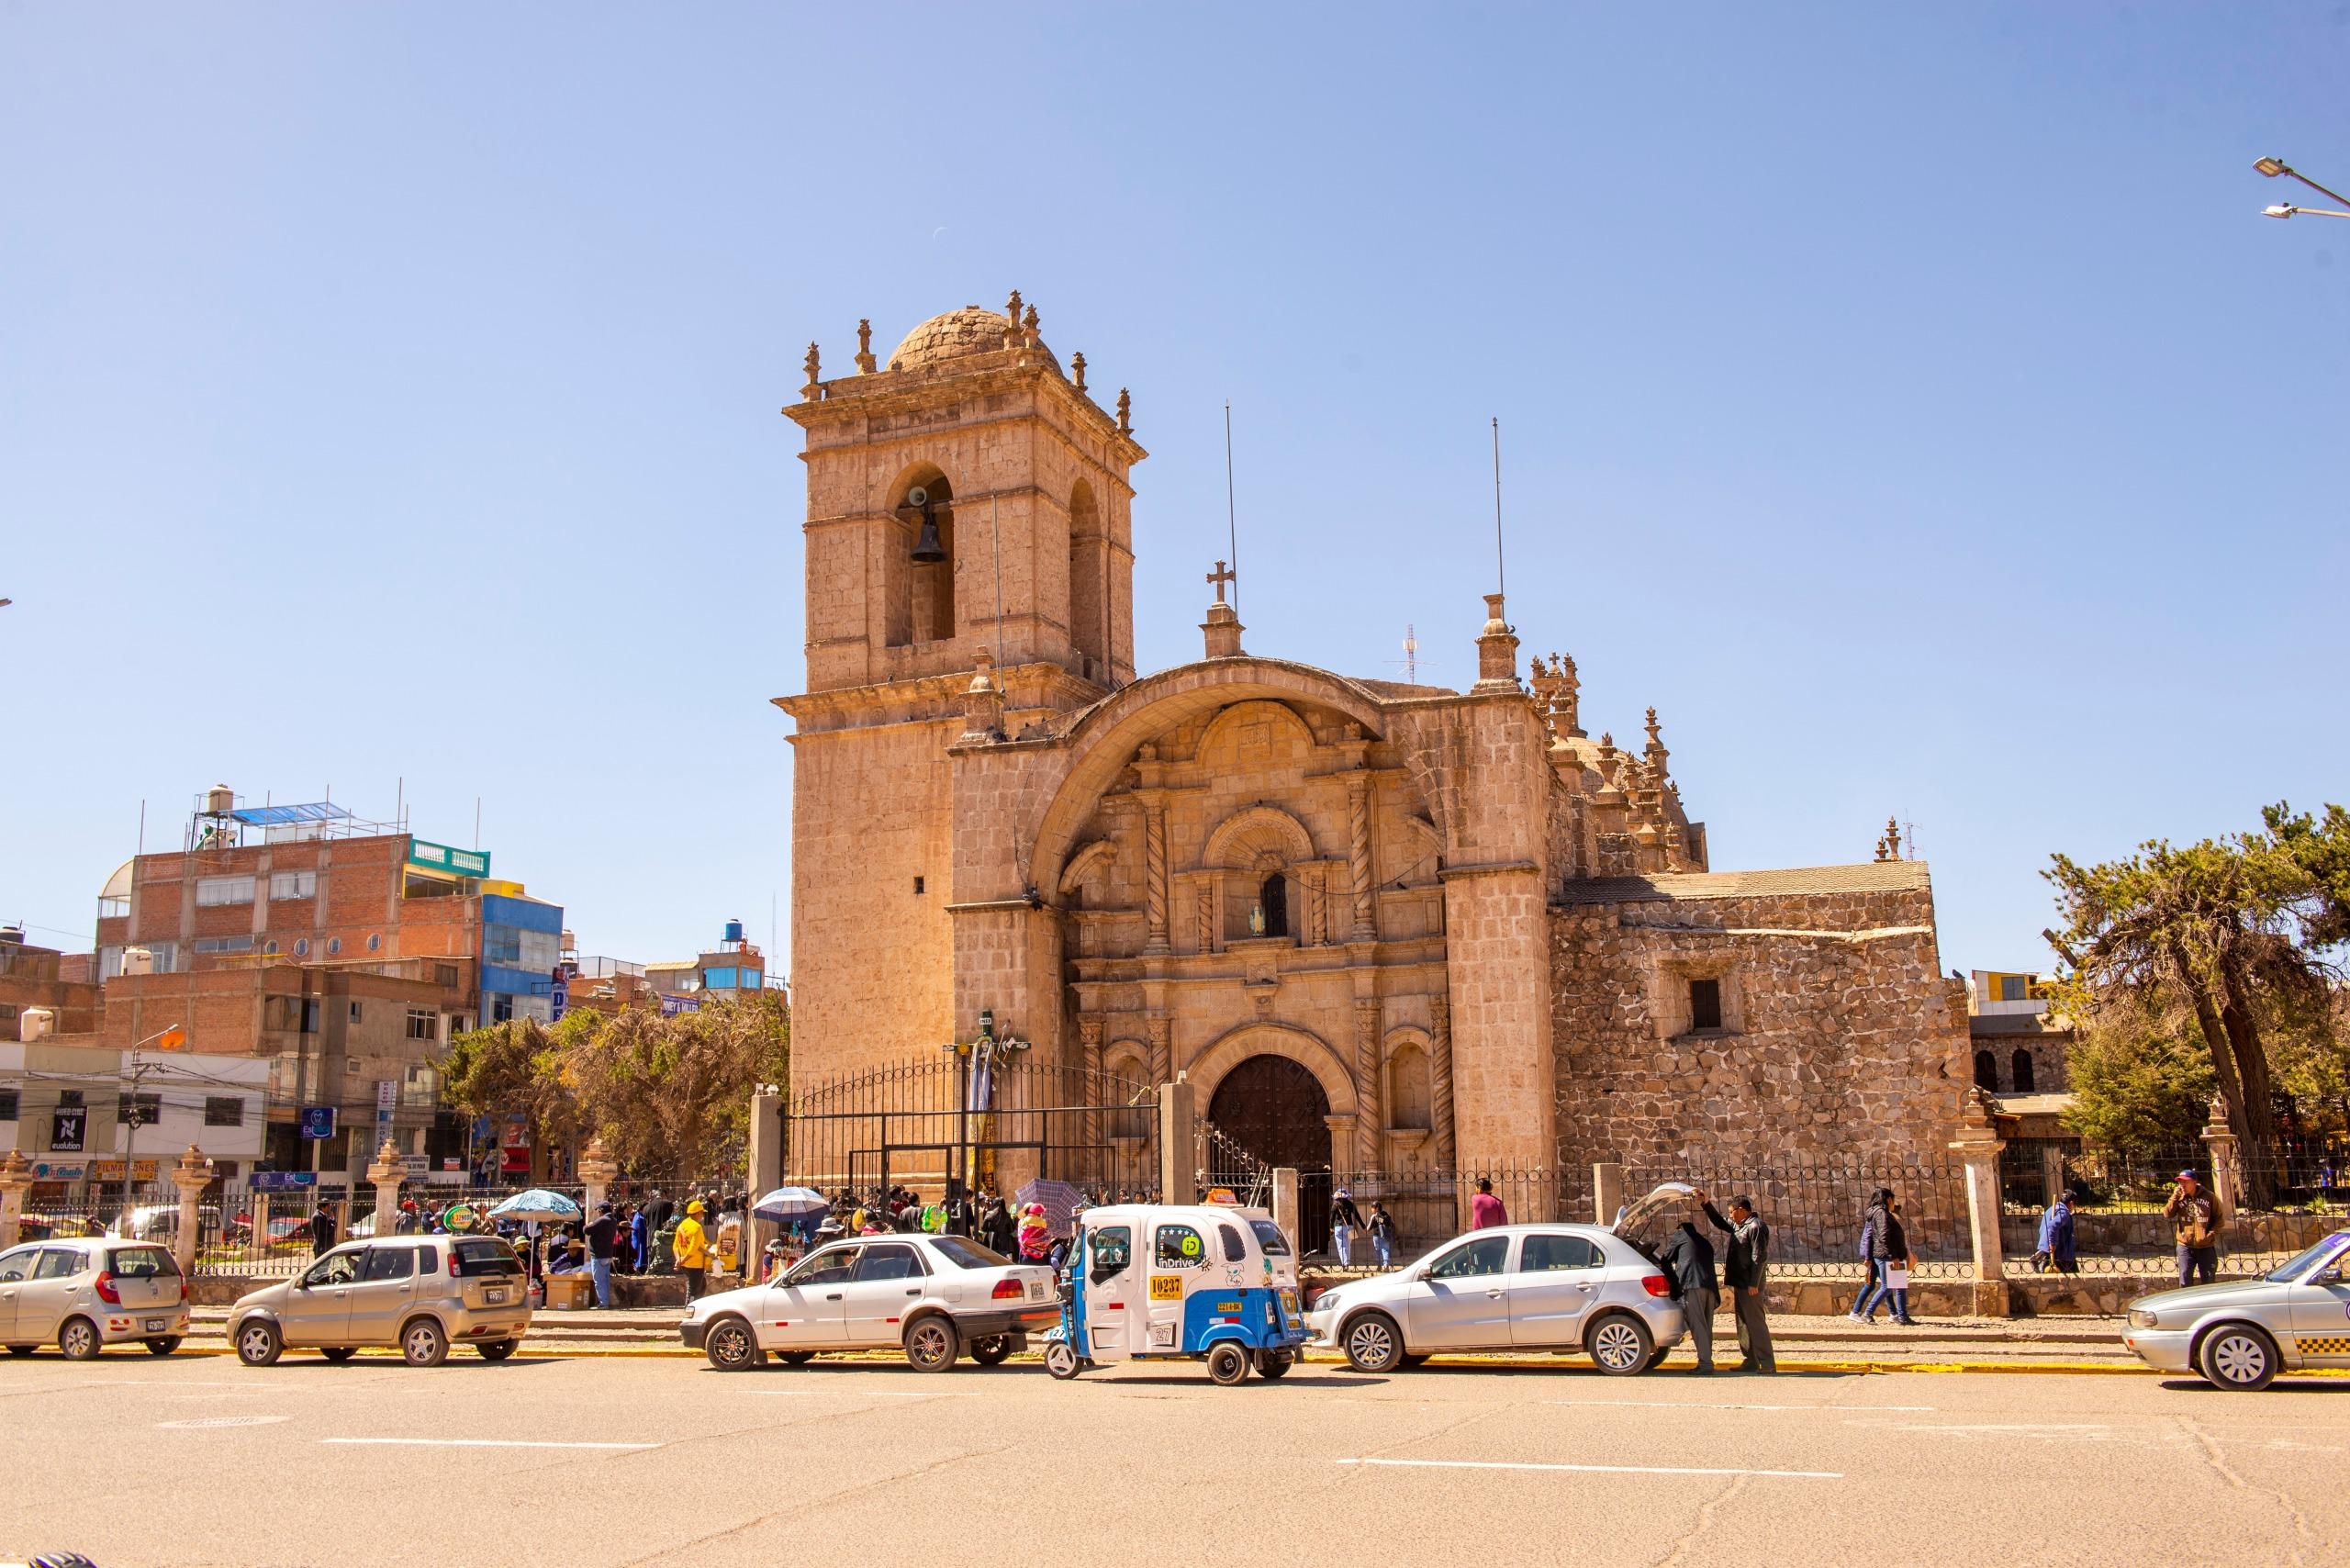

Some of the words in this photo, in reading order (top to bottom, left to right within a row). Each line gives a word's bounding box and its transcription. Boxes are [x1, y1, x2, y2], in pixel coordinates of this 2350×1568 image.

[96, 1163, 155, 1172] FILMACONES
[1158, 1258, 1195, 1269] inDrive
[1152, 1278, 1181, 1294] 10237
[1156, 1327, 1171, 1341] 27
